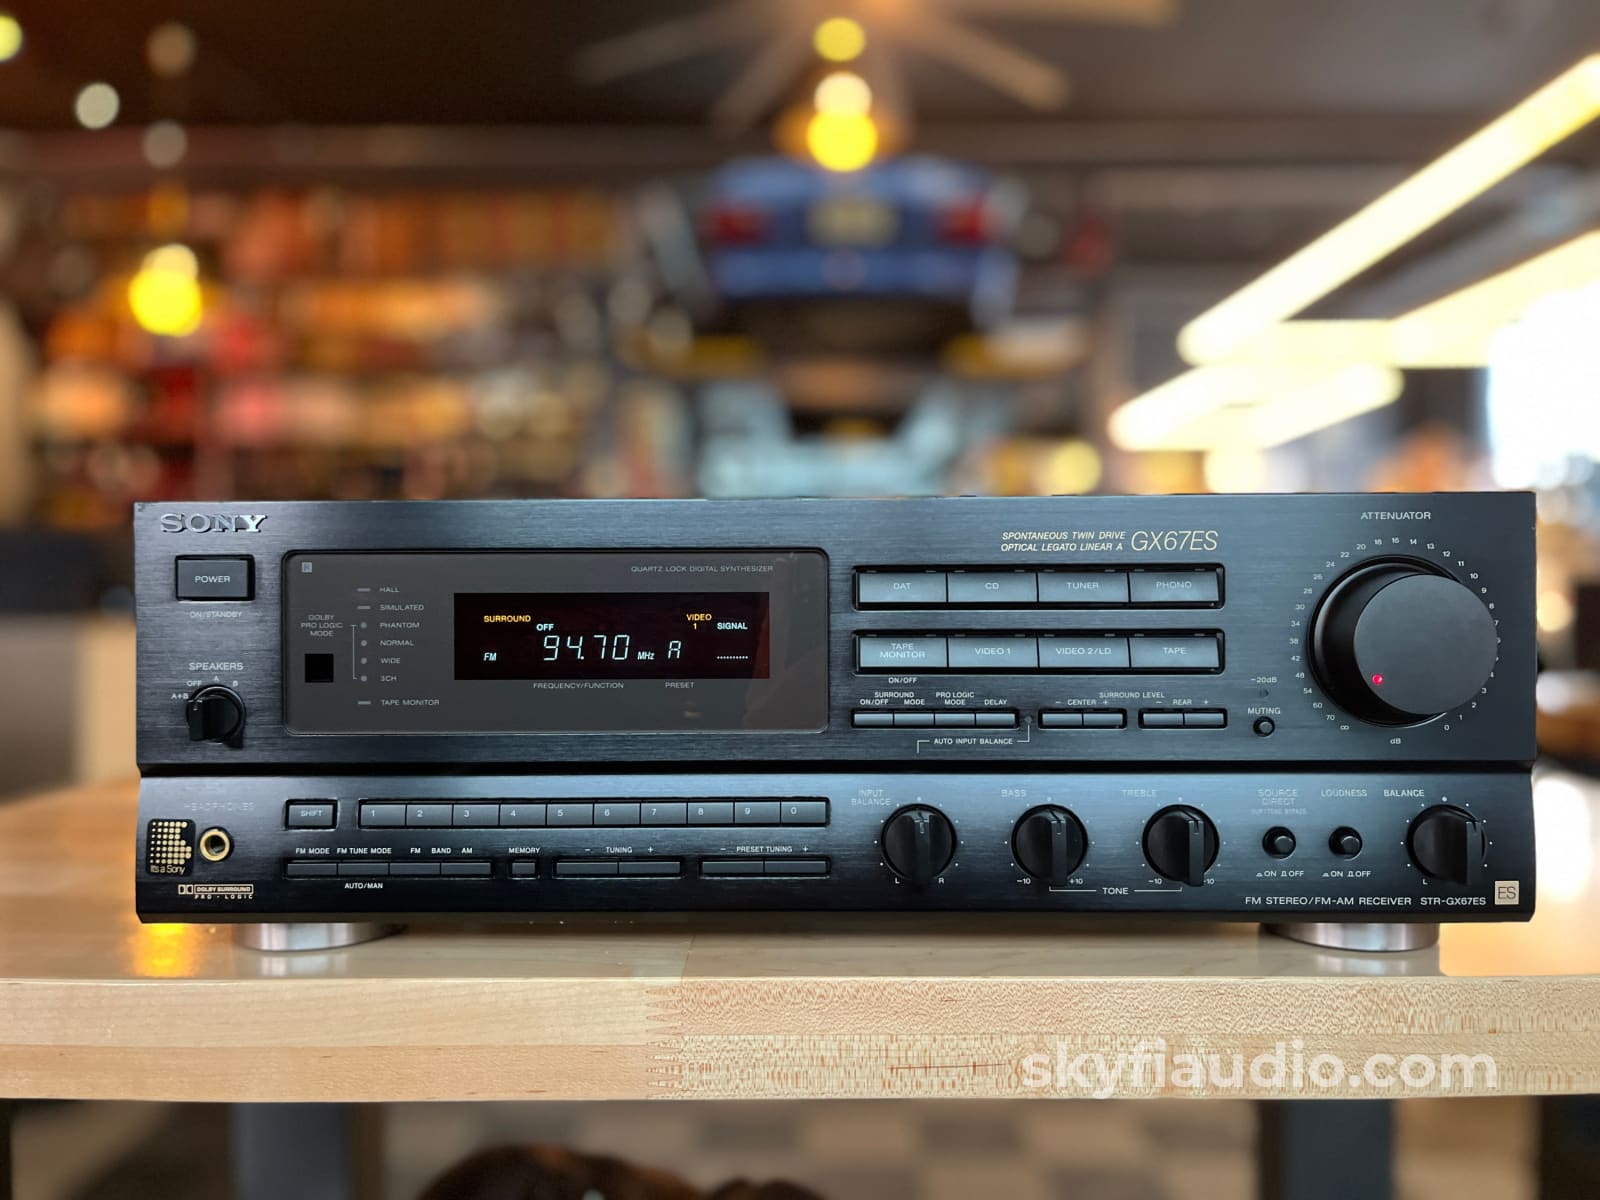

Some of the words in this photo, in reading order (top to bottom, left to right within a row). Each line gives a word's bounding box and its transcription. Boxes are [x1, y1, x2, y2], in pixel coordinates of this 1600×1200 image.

[1361, 512, 1432, 520] ATTENUATOR
[160, 513, 268, 533] SONY
[1002, 532, 1068, 540] SPONTANEOUS
[1072, 532, 1094, 540] TWIN
[1098, 531, 1126, 540] DRIVE
[1130, 530, 1218, 550] GX67ES
[1001, 543, 1038, 552] OPTICAL
[1042, 543, 1077, 551] LEGATO
[194, 575, 231, 583] POWER
[1156, 581, 1192, 589] PHONO
[483, 615, 532, 623] SURROUND
[693, 622, 697, 630] 1
[717, 622, 748, 630] SIGNAL
[484, 652, 497, 661] FM
[544, 635, 630, 660] 94.70
[637, 651, 655, 660] MHz
[667, 640, 682, 659] A
[189, 662, 244, 671] SPEAKERS
[1321, 789, 1368, 797] LOUDNESS
[1384, 789, 1425, 797] BALANCE
[652, 808, 657, 816] 7
[166, 865, 185, 875] Sony
[1102, 887, 1129, 895] TONE
[1498, 886, 1516, 900] ES
[1245, 897, 1262, 906] FM
[1265, 896, 1354, 906] STEREO/FM-AM
[1359, 896, 1412, 906] RECEIVER
[1420, 896, 1486, 906] STR-GX67ES
